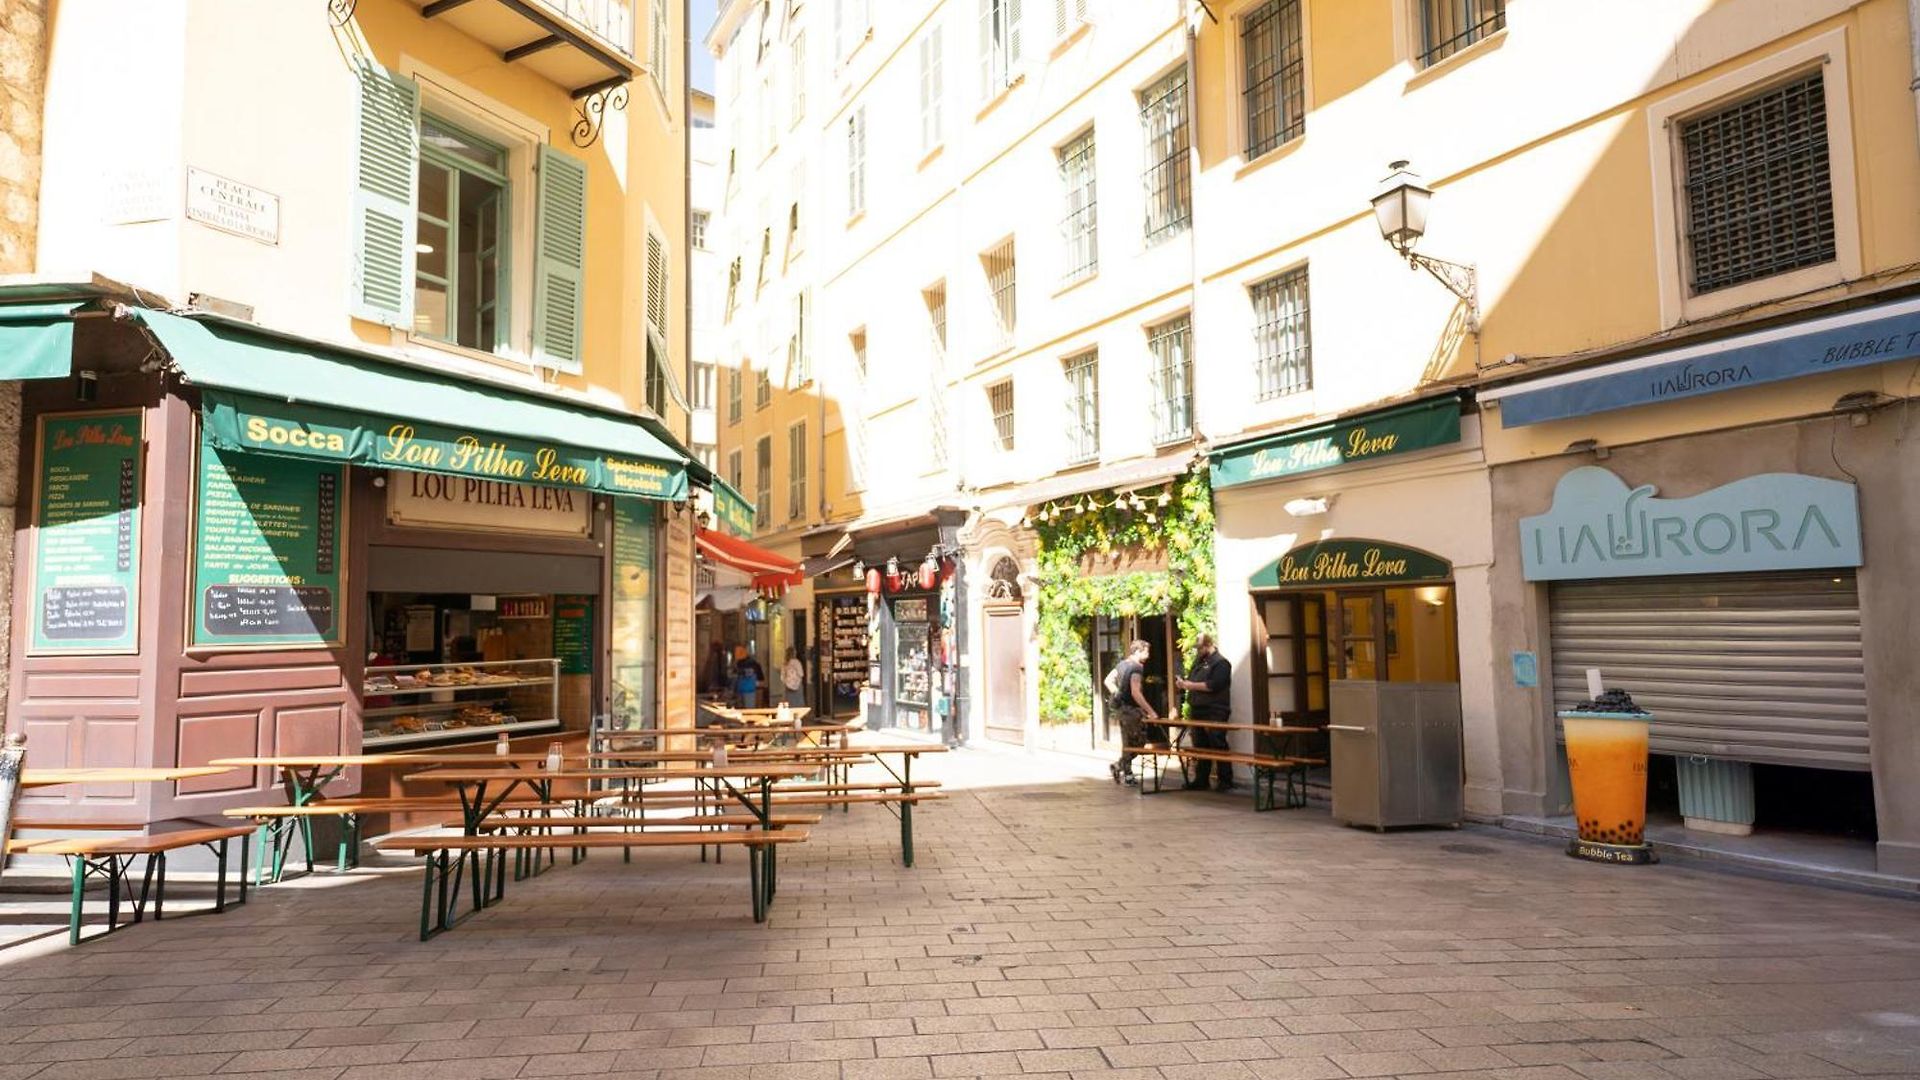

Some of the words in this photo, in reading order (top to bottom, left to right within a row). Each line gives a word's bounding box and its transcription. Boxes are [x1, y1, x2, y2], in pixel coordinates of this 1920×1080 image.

[1822, 334, 1902, 365] BUBBLE
[246, 415, 345, 452] Socca
[1250, 449, 1284, 477] Lou
[1287, 437, 1343, 470] Pilha
[1345, 427, 1399, 458] Leva
[382, 424, 441, 467] Lou
[450, 435, 528, 478] Pilha
[531, 447, 589, 484] Leva
[410, 471, 457, 502] LOU
[463, 477, 525, 508] PILHA
[531, 484, 574, 512] LEVA
[1279, 554, 1309, 583] Lou
[1312, 552, 1359, 581] Pilha
[1361, 548, 1407, 577] Leva
[1579, 846, 1613, 860] Bubble
[1614, 851, 1633, 862] Tea
